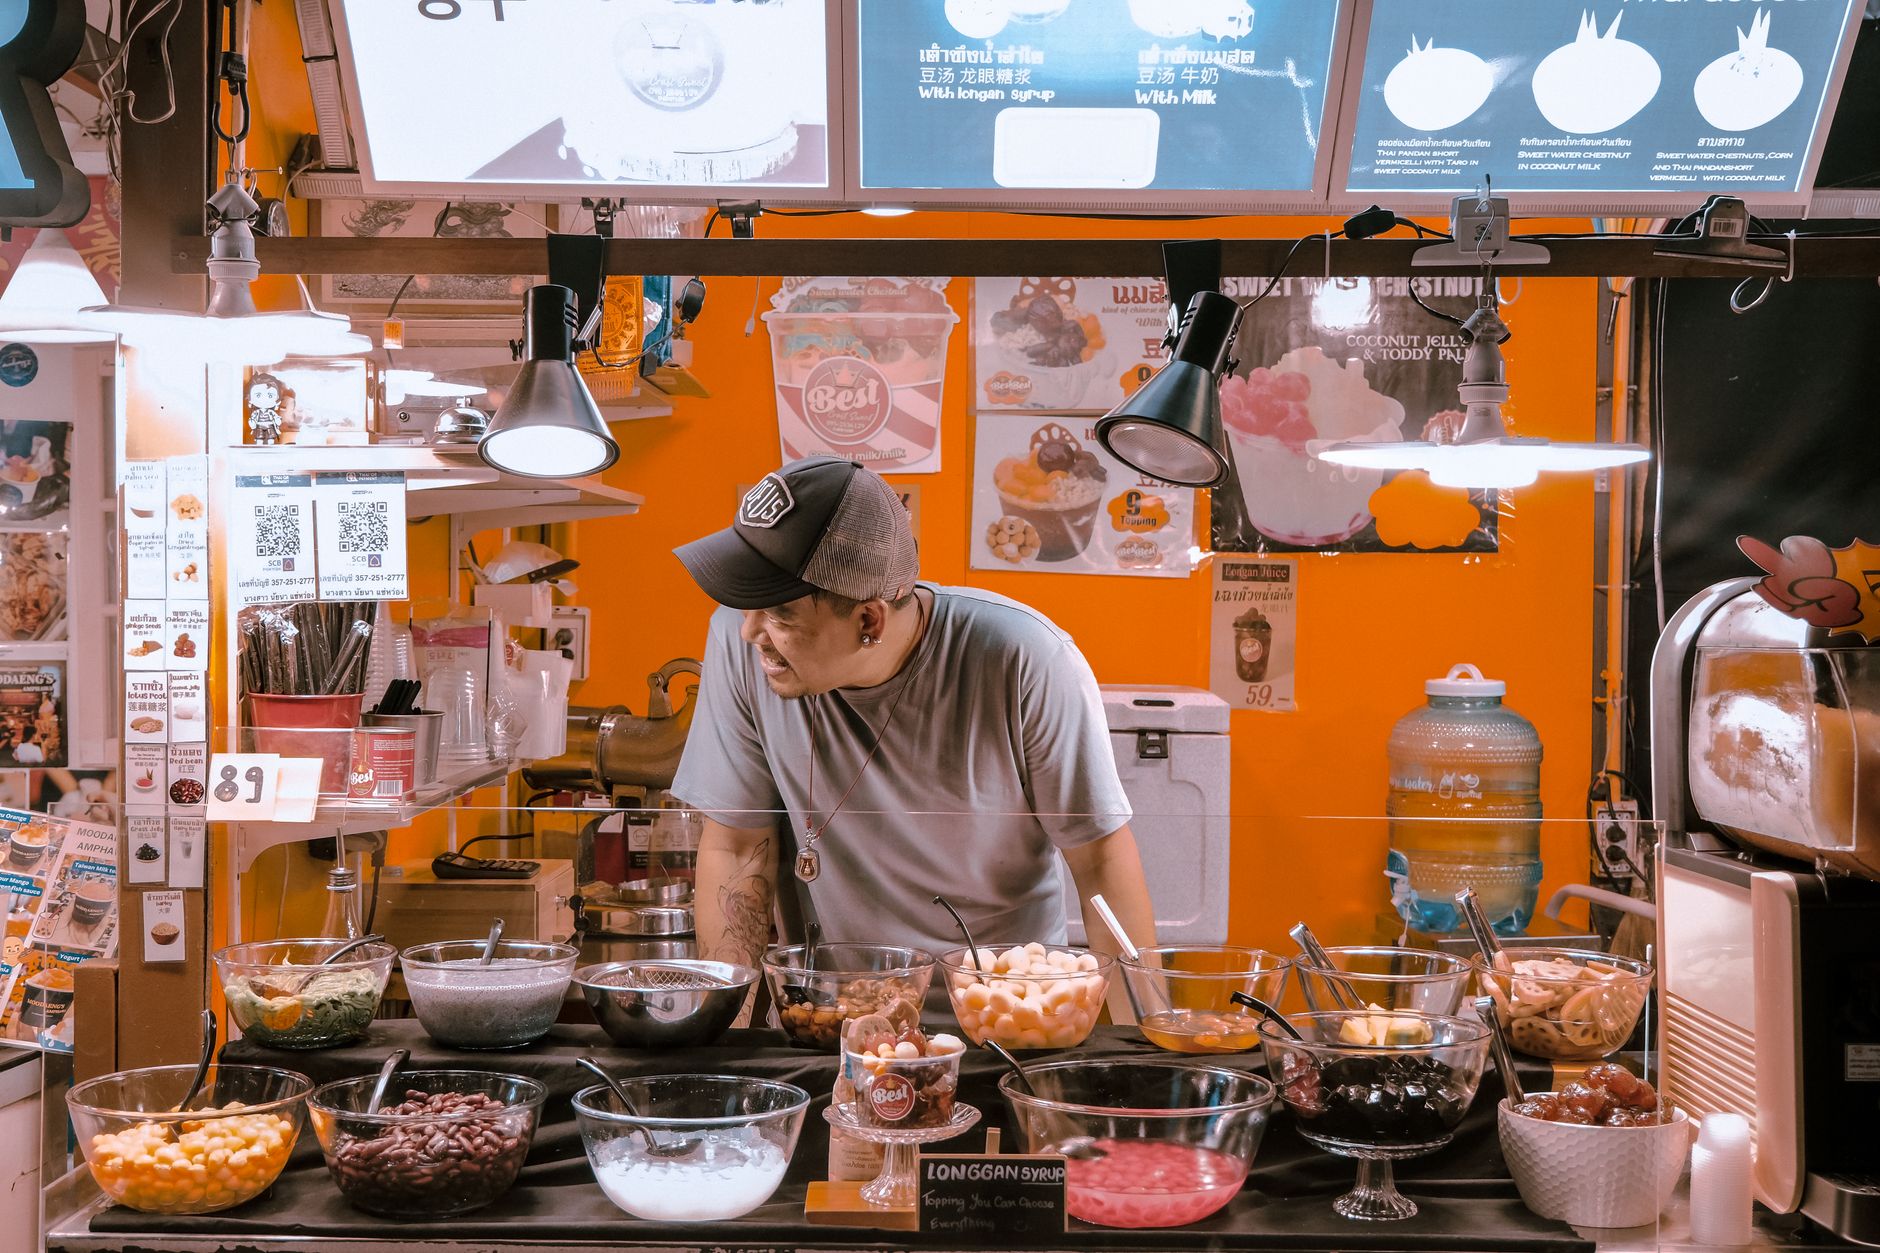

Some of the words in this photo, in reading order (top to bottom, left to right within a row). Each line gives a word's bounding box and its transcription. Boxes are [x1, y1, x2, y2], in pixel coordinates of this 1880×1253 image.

[920, 67, 954, 83] 豆汤
[960, 68, 1032, 84] 龙眼糖浆
[1136, 67, 1175, 84] 豆汤
[1181, 66, 1219, 85] 牛奶
[919, 86, 954, 99] With
[958, 86, 1004, 102] longan
[1011, 89, 1055, 103] syrup
[1135, 89, 1178, 104] With
[1182, 89, 1216, 104] Milk
[1550, 151, 1582, 159] WATER
[1223, 277, 1291, 297] SWEET
[1346, 335, 1421, 347] COCONUT
[1425, 335, 1466, 349] JELLY
[1364, 349, 1376, 364] &
[1380, 348, 1432, 361] TODDY
[1439, 348, 1469, 364] PAL
[807, 378, 880, 414] Best
[1126, 491, 1141, 515] 9
[1120, 515, 1157, 527] Topping
[355, 574, 405, 582] 357-251-2777
[1225, 565, 1258, 579] Longan
[1261, 565, 1287, 578] Juice
[271, 577, 315, 586] 357-251-2777
[132, 680, 163, 691] รากบัว
[128, 691, 148, 699] lotus
[178, 764, 196, 773] 红豆
[351, 769, 374, 785] Best
[6, 813, 27, 822] Orange
[77, 828, 117, 841] MOODA
[77, 842, 117, 856] AMPHA
[10, 877, 30, 886] Mango
[60, 953, 80, 962] Yogurt
[871, 1086, 908, 1105] Best
[927, 1162, 1018, 1181] LONGGAN
[922, 1190, 965, 1212] Topping
[994, 1195, 1016, 1208] Can
